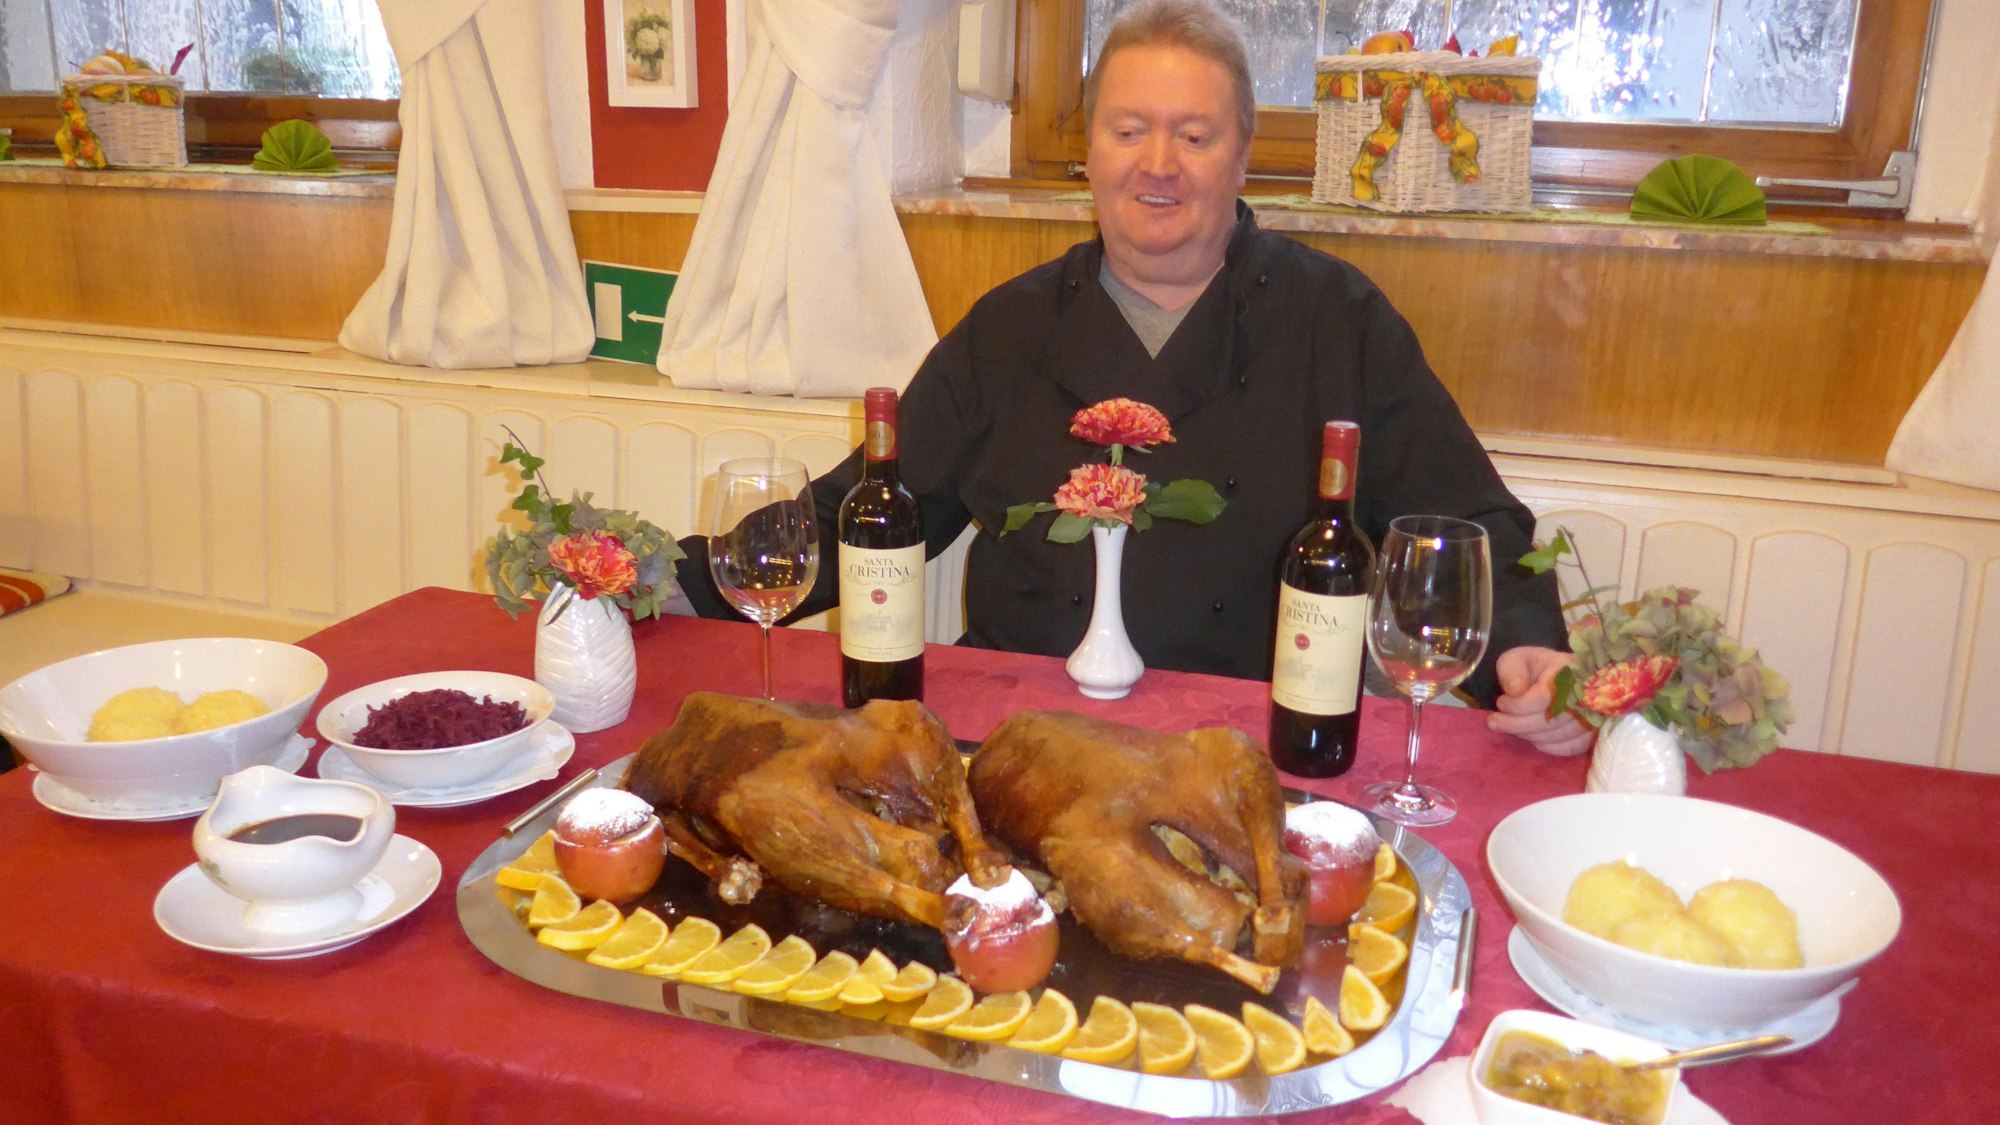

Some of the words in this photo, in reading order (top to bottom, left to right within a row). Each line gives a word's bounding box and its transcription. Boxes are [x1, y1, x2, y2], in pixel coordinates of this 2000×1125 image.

[864, 557, 894, 567] SANTA
[849, 564, 910, 578] CRISTINA
[1292, 599, 1322, 613] SANTA
